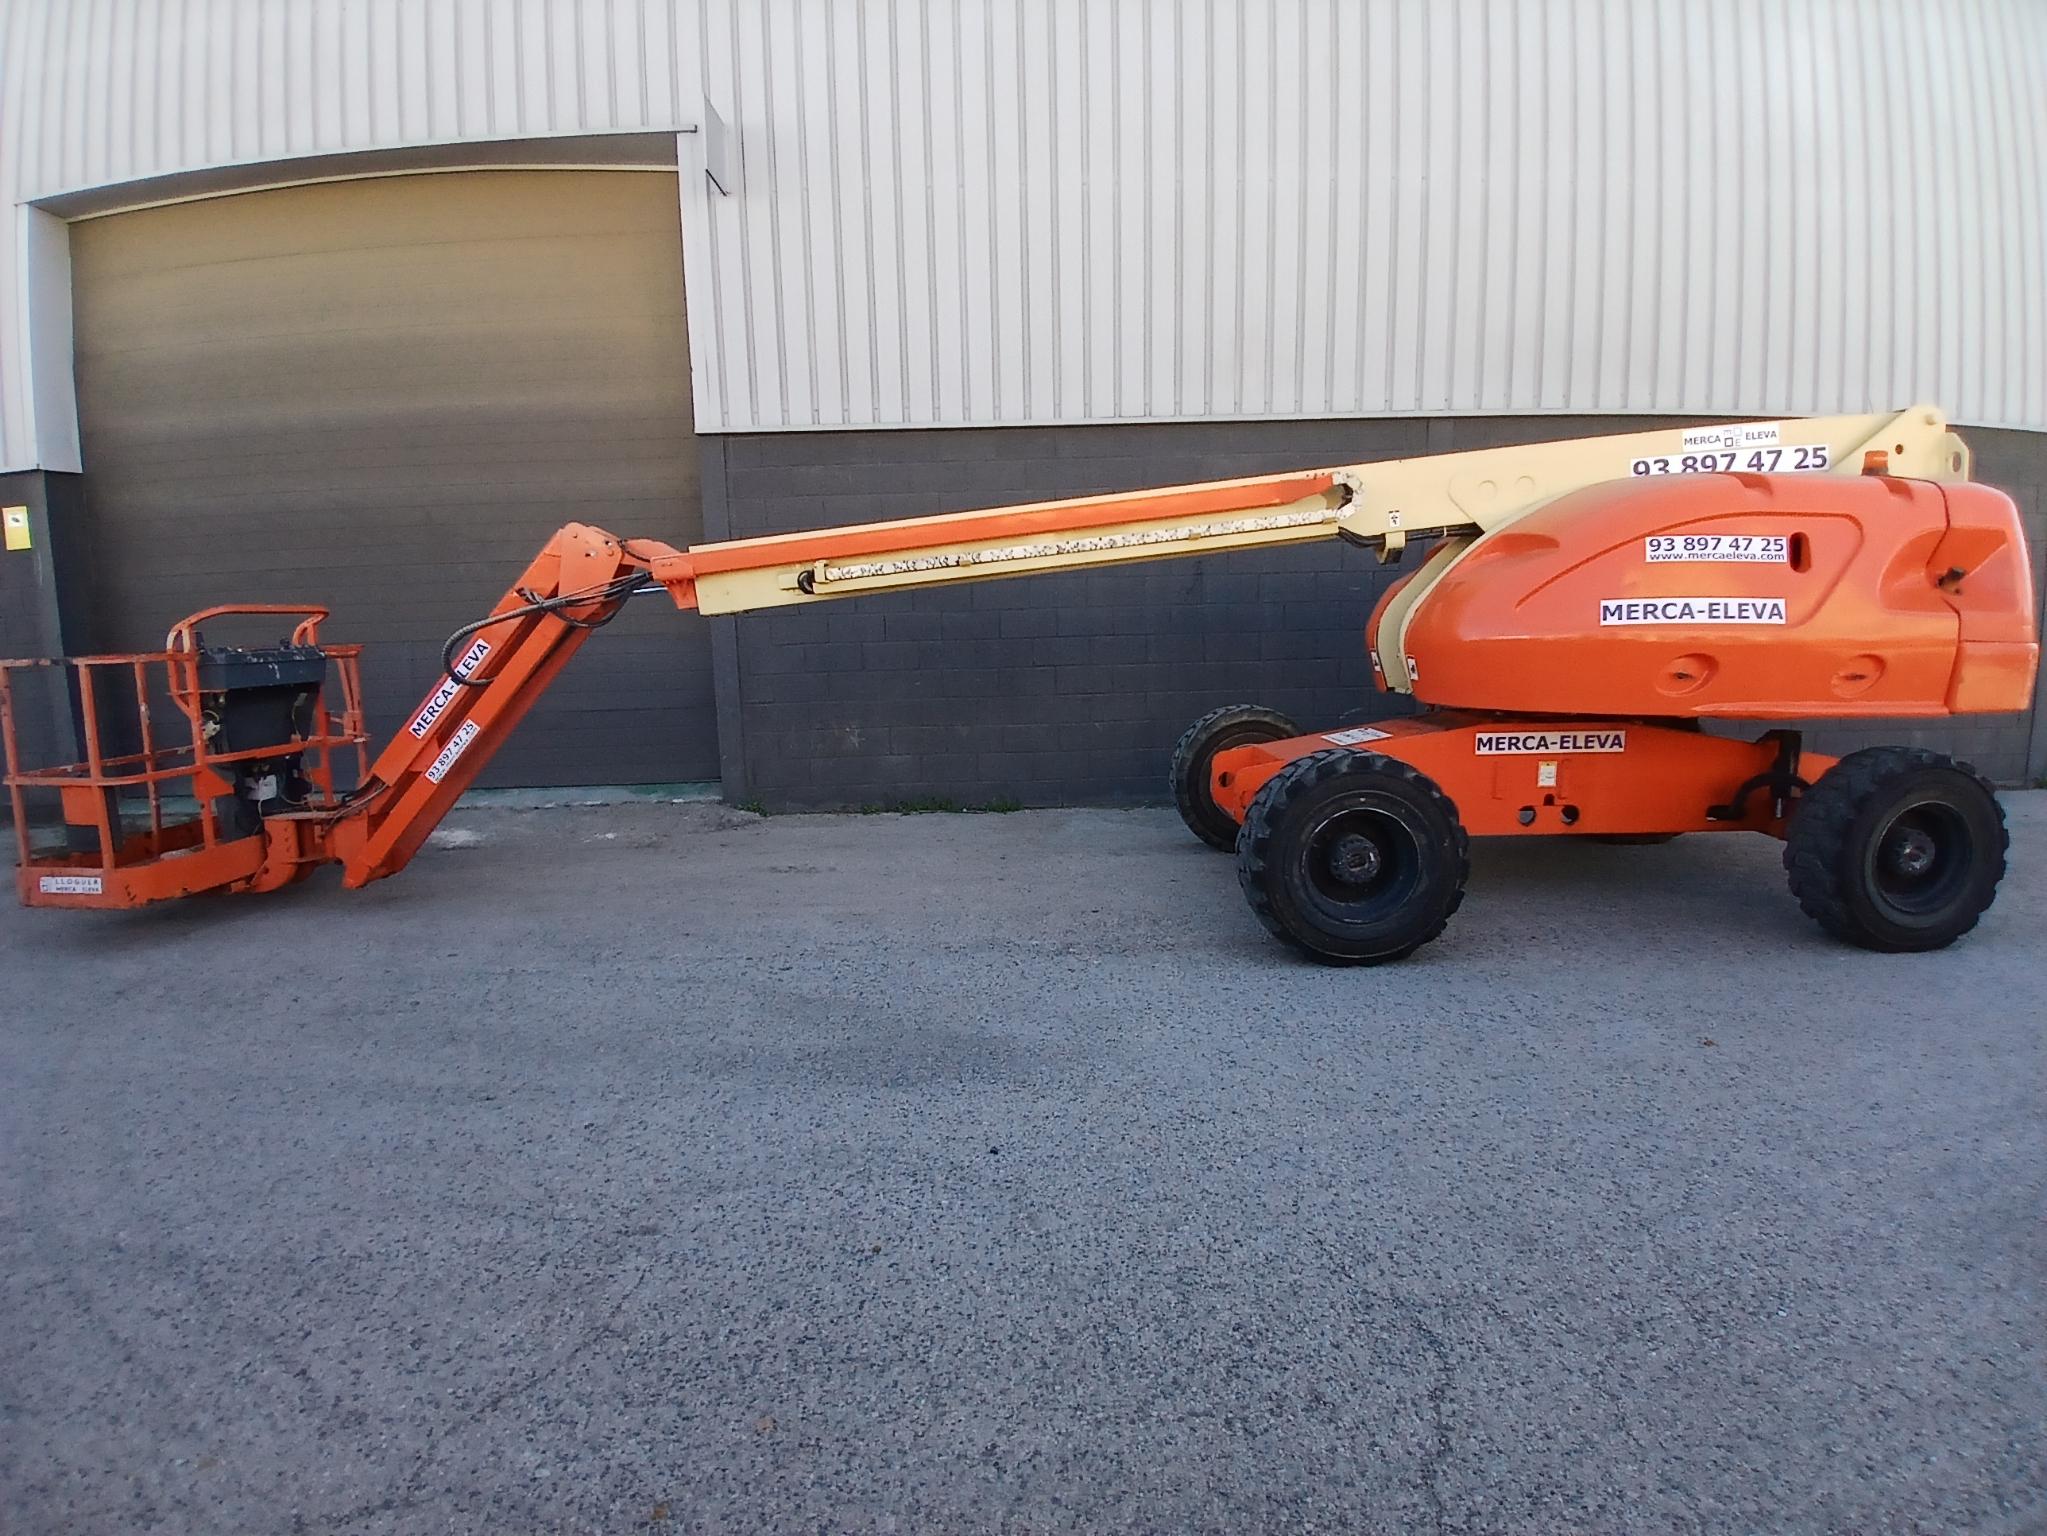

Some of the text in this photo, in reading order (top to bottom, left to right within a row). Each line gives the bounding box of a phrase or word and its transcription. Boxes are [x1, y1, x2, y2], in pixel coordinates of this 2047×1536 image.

[1684, 430, 1778, 446] MERCA ELEVA
[1633, 447, 1828, 476] 93 897 47 25
[1649, 537, 1785, 552] 93 897 47 25
[1650, 551, 1786, 561] www.mercaeleva.com
[1602, 603, 1783, 621] MERCA-ELEVA
[411, 643, 489, 737] MERCA-LEVA
[428, 722, 474, 779] 93 897 47 25
[1476, 734, 1623, 751] MERCA-ELEVA
